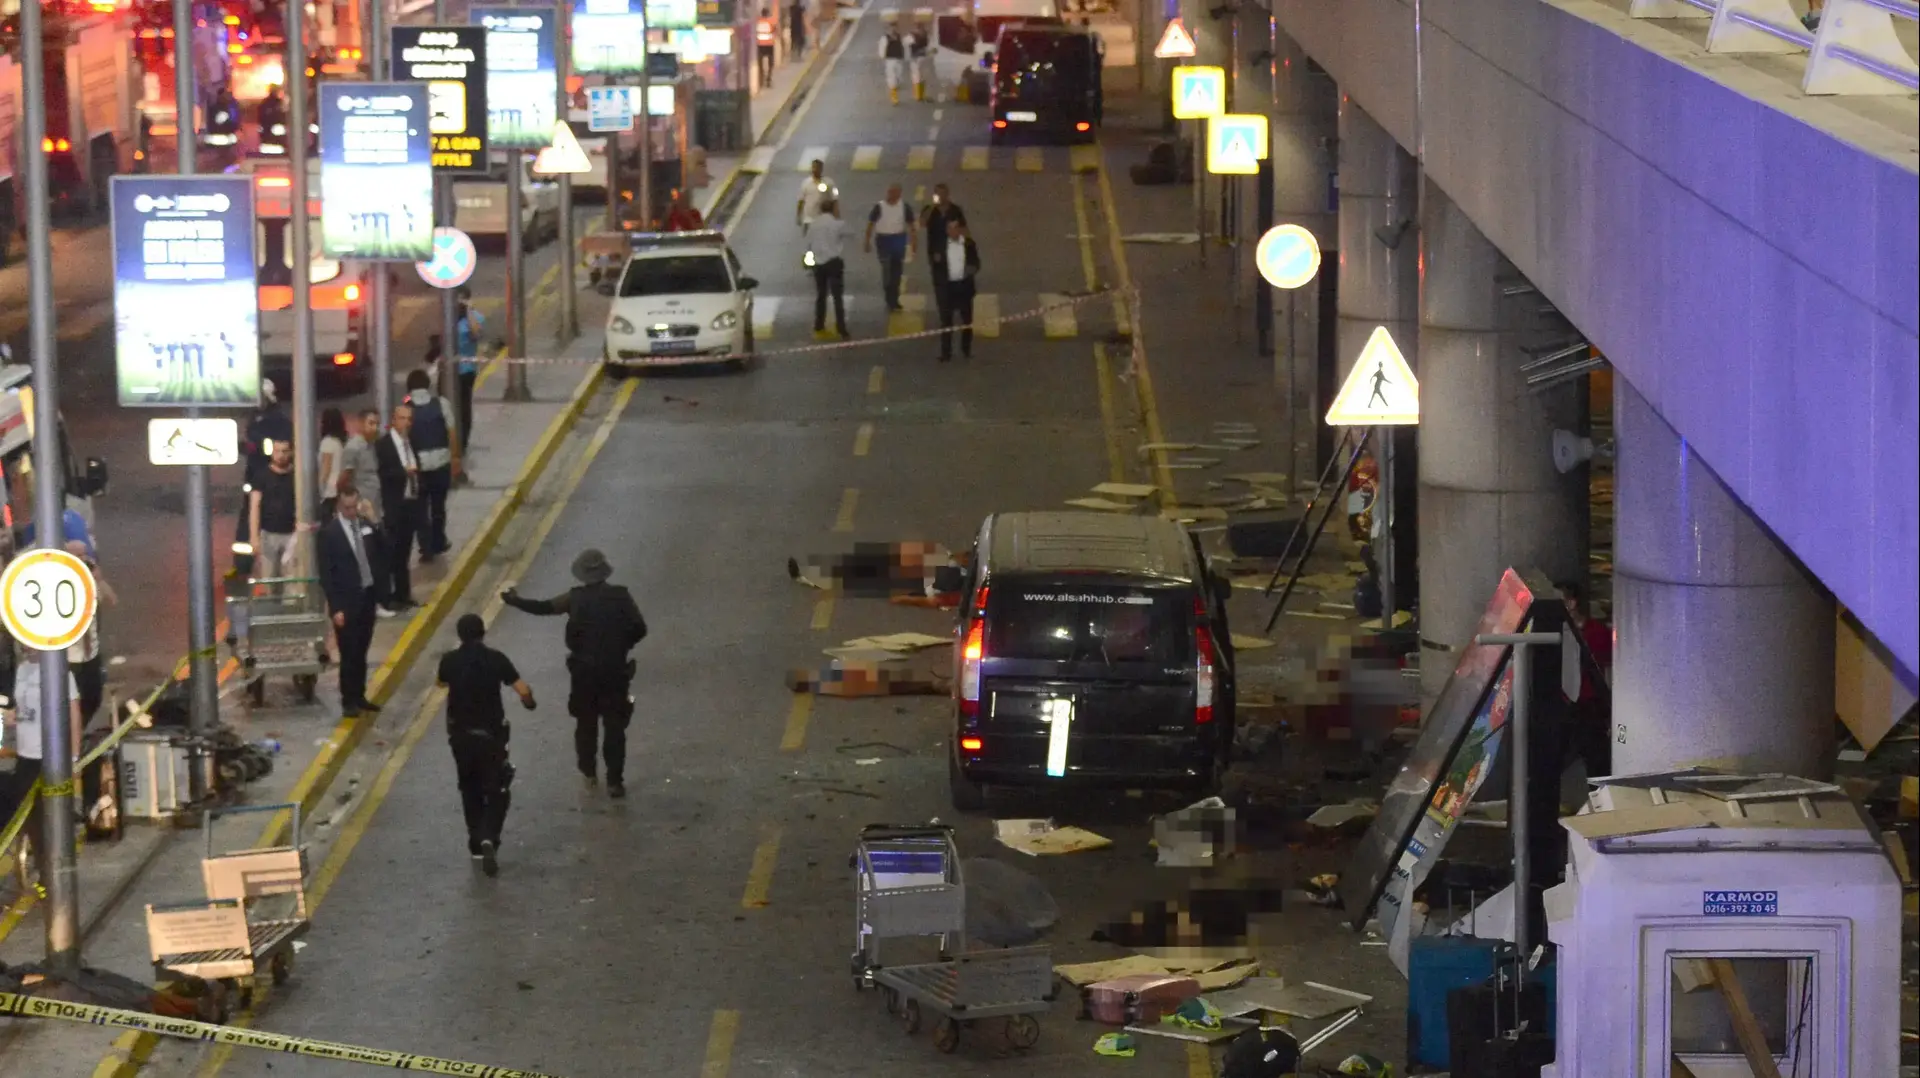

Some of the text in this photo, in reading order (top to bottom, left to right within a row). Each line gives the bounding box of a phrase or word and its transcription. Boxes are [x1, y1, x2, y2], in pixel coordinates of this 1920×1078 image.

[24, 579, 76, 618] 30
[1023, 593, 1152, 605] www.alsahhab.c
[1705, 892, 1776, 902] KARMOD
[1751, 904, 1762, 913] 20
[1764, 904, 1776, 913] 45
